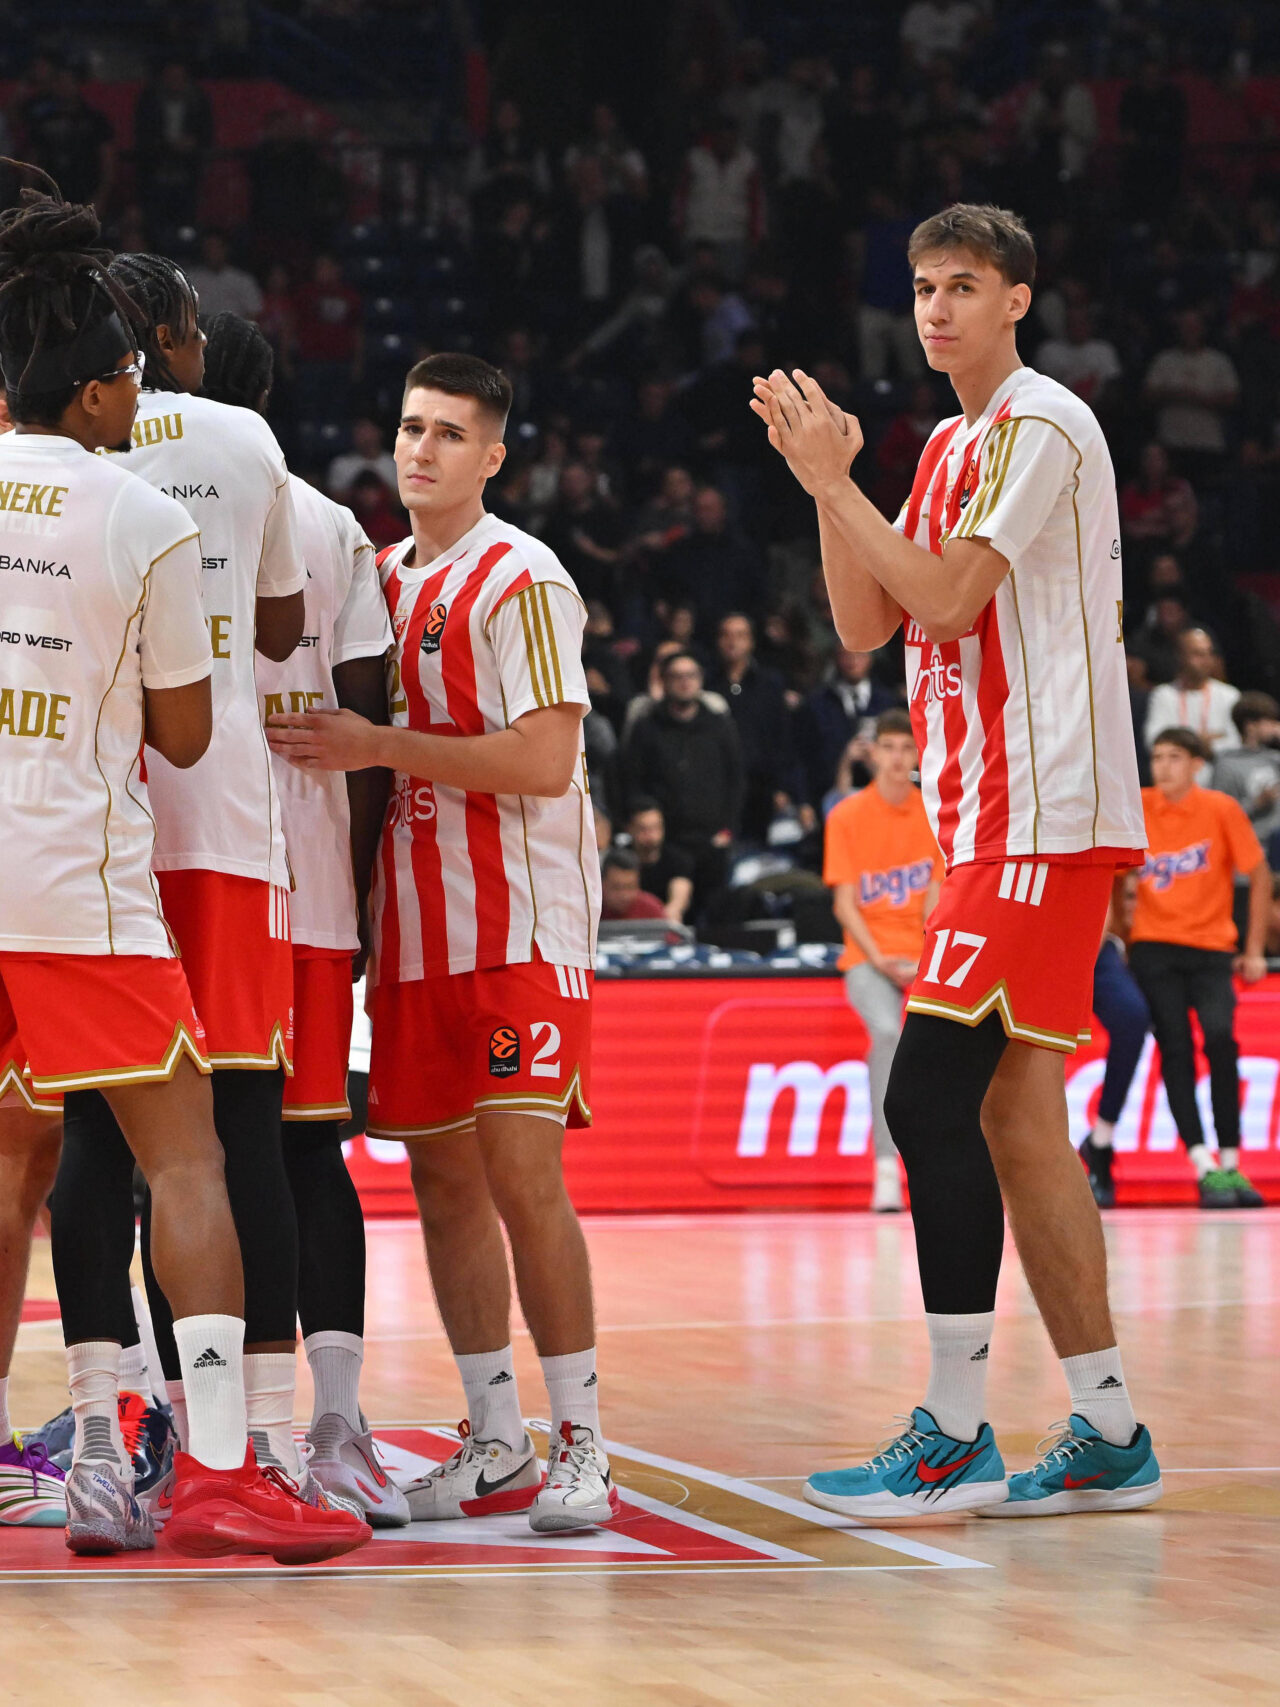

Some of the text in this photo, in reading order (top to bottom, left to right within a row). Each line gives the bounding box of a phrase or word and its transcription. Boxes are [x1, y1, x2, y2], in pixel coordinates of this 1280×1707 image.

[202, 558, 228, 570] EST
[25, 633, 73, 652] WEST
[923, 929, 988, 988] 17
[529, 1021, 561, 1078] 2
[193, 1360, 227, 1368] adidas
[93, 1473, 117, 1497] TWELVE
